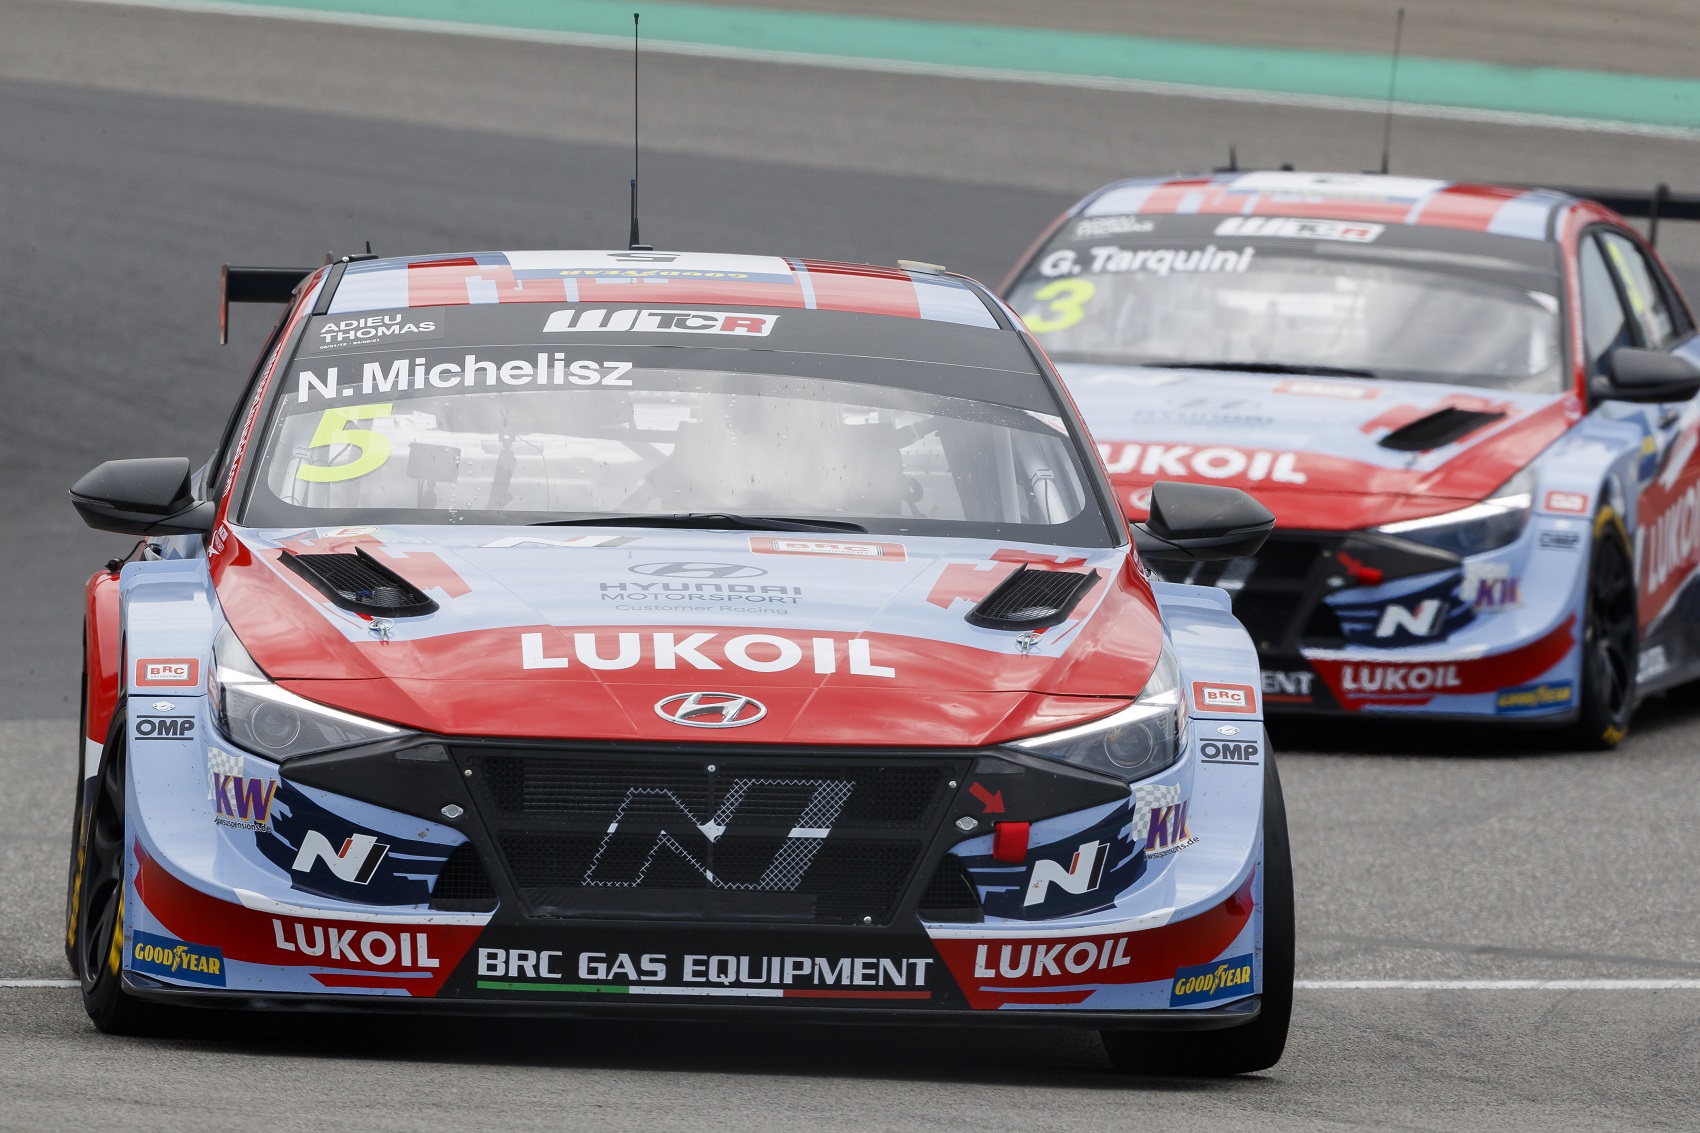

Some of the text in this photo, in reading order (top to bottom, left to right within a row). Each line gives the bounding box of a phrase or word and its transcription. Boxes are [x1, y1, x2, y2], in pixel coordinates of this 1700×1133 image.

[1040, 245, 1256, 277] G. Tarquini
[1021, 278, 1097, 334] 3
[320, 313, 402, 333] ADIEU
[320, 321, 436, 343] THOMAS
[543, 308, 782, 337] WTCR
[295, 402, 394, 483] 5
[1098, 443, 1309, 485] UKOIL
[785, 542, 870, 552] BRC
[599, 582, 802, 596] HYUNDAI
[600, 592, 803, 604] MOTORSPORT
[614, 603, 788, 616] Customer Racing
[150, 665, 185, 675] BRC
[520, 632, 896, 678] LUKOIL
[1341, 664, 1463, 691] LUKOIL
[1207, 690, 1242, 701] BRC
[135, 718, 195, 737] OMP
[1200, 742, 1259, 761] OMP
[213, 771, 279, 823] KW
[1144, 799, 1191, 852] KW
[271, 918, 440, 968] LUKOIL
[973, 937, 1132, 979] LUKOIL
[134, 942, 221, 976] GOODYEAR
[477, 947, 934, 986] BRC GAS EQUIPMENT
[1175, 963, 1251, 996] GOODYEAR
